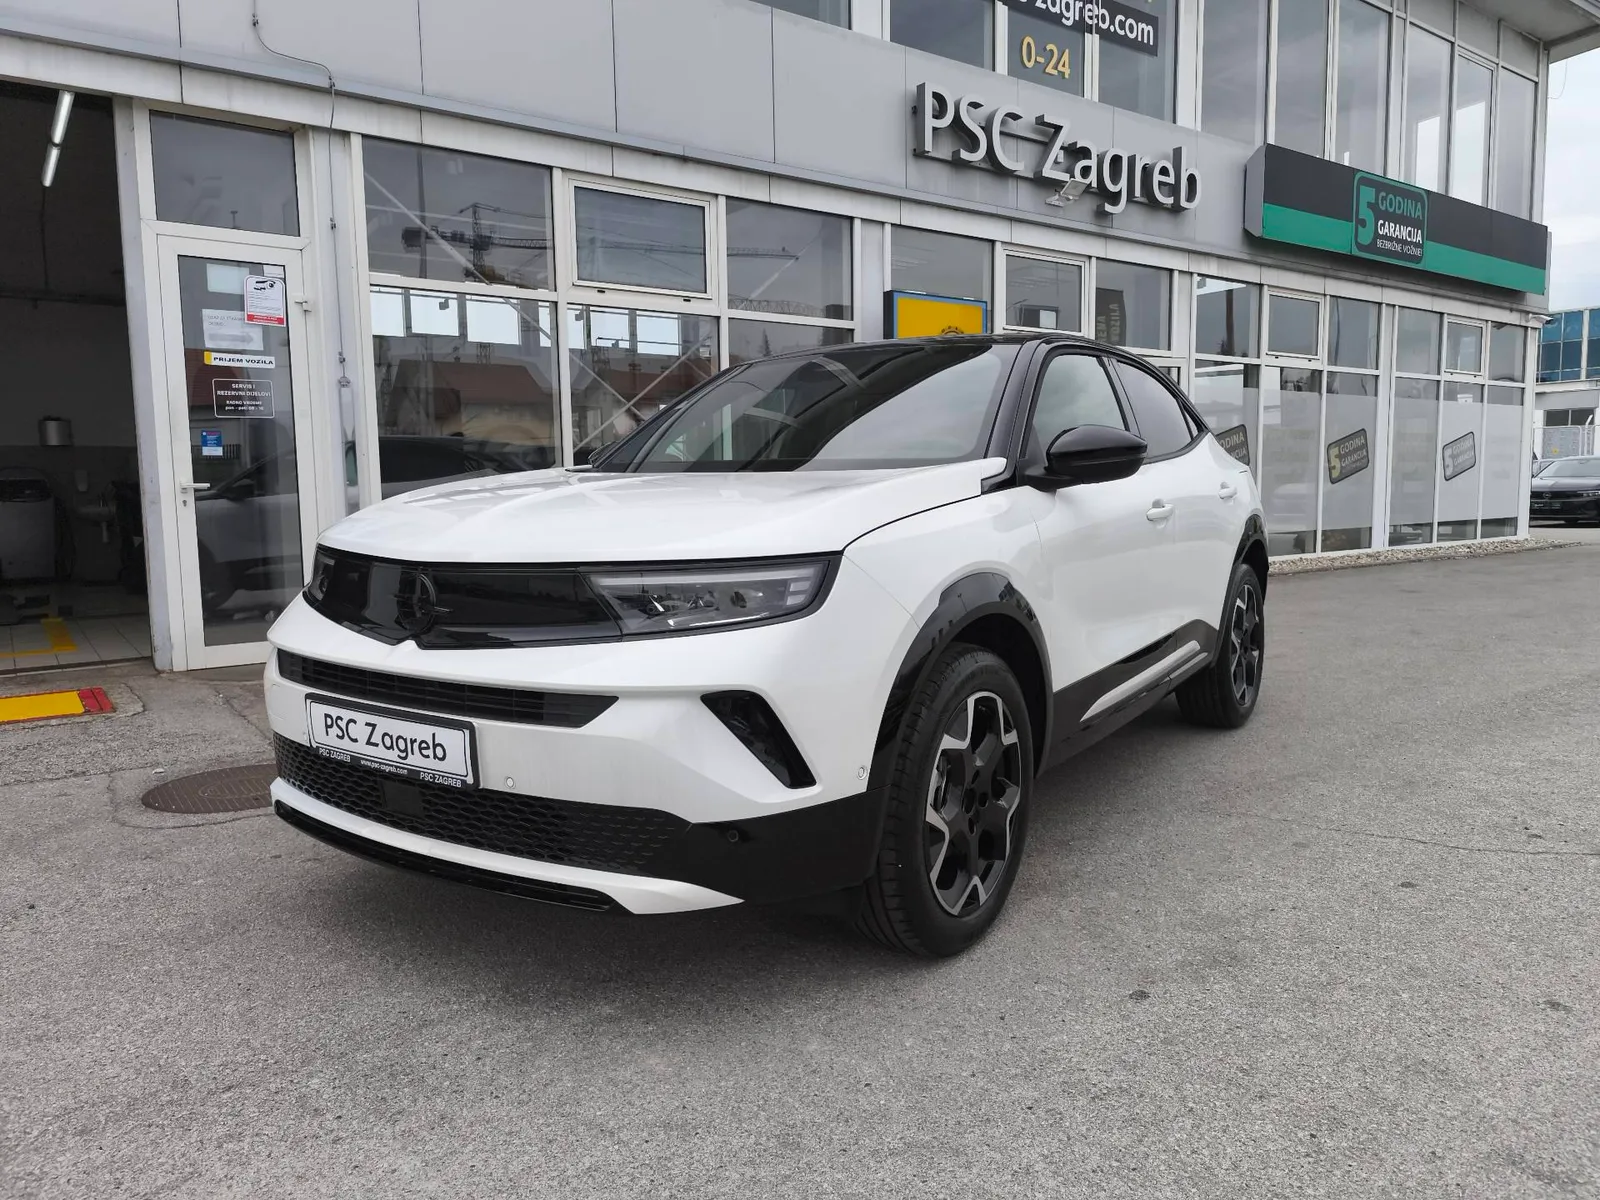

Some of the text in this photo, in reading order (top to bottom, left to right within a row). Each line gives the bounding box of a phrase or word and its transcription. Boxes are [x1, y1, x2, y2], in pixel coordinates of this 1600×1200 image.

[1022, 35, 1071, 79] 0-24
[918, 82, 1201, 214] PSC Zagreb
[1357, 184, 1423, 246] 5 GODINA
[1377, 219, 1423, 244] GARANCIJA
[1220, 431, 1245, 449] ODINA
[1330, 446, 1341, 478] 5
[1340, 435, 1365, 454] GODINA
[318, 747, 351, 762] PSC ZAGREB
[323, 712, 448, 762] PSC Zagreb
[420, 771, 462, 788] PSC ZAGREB
